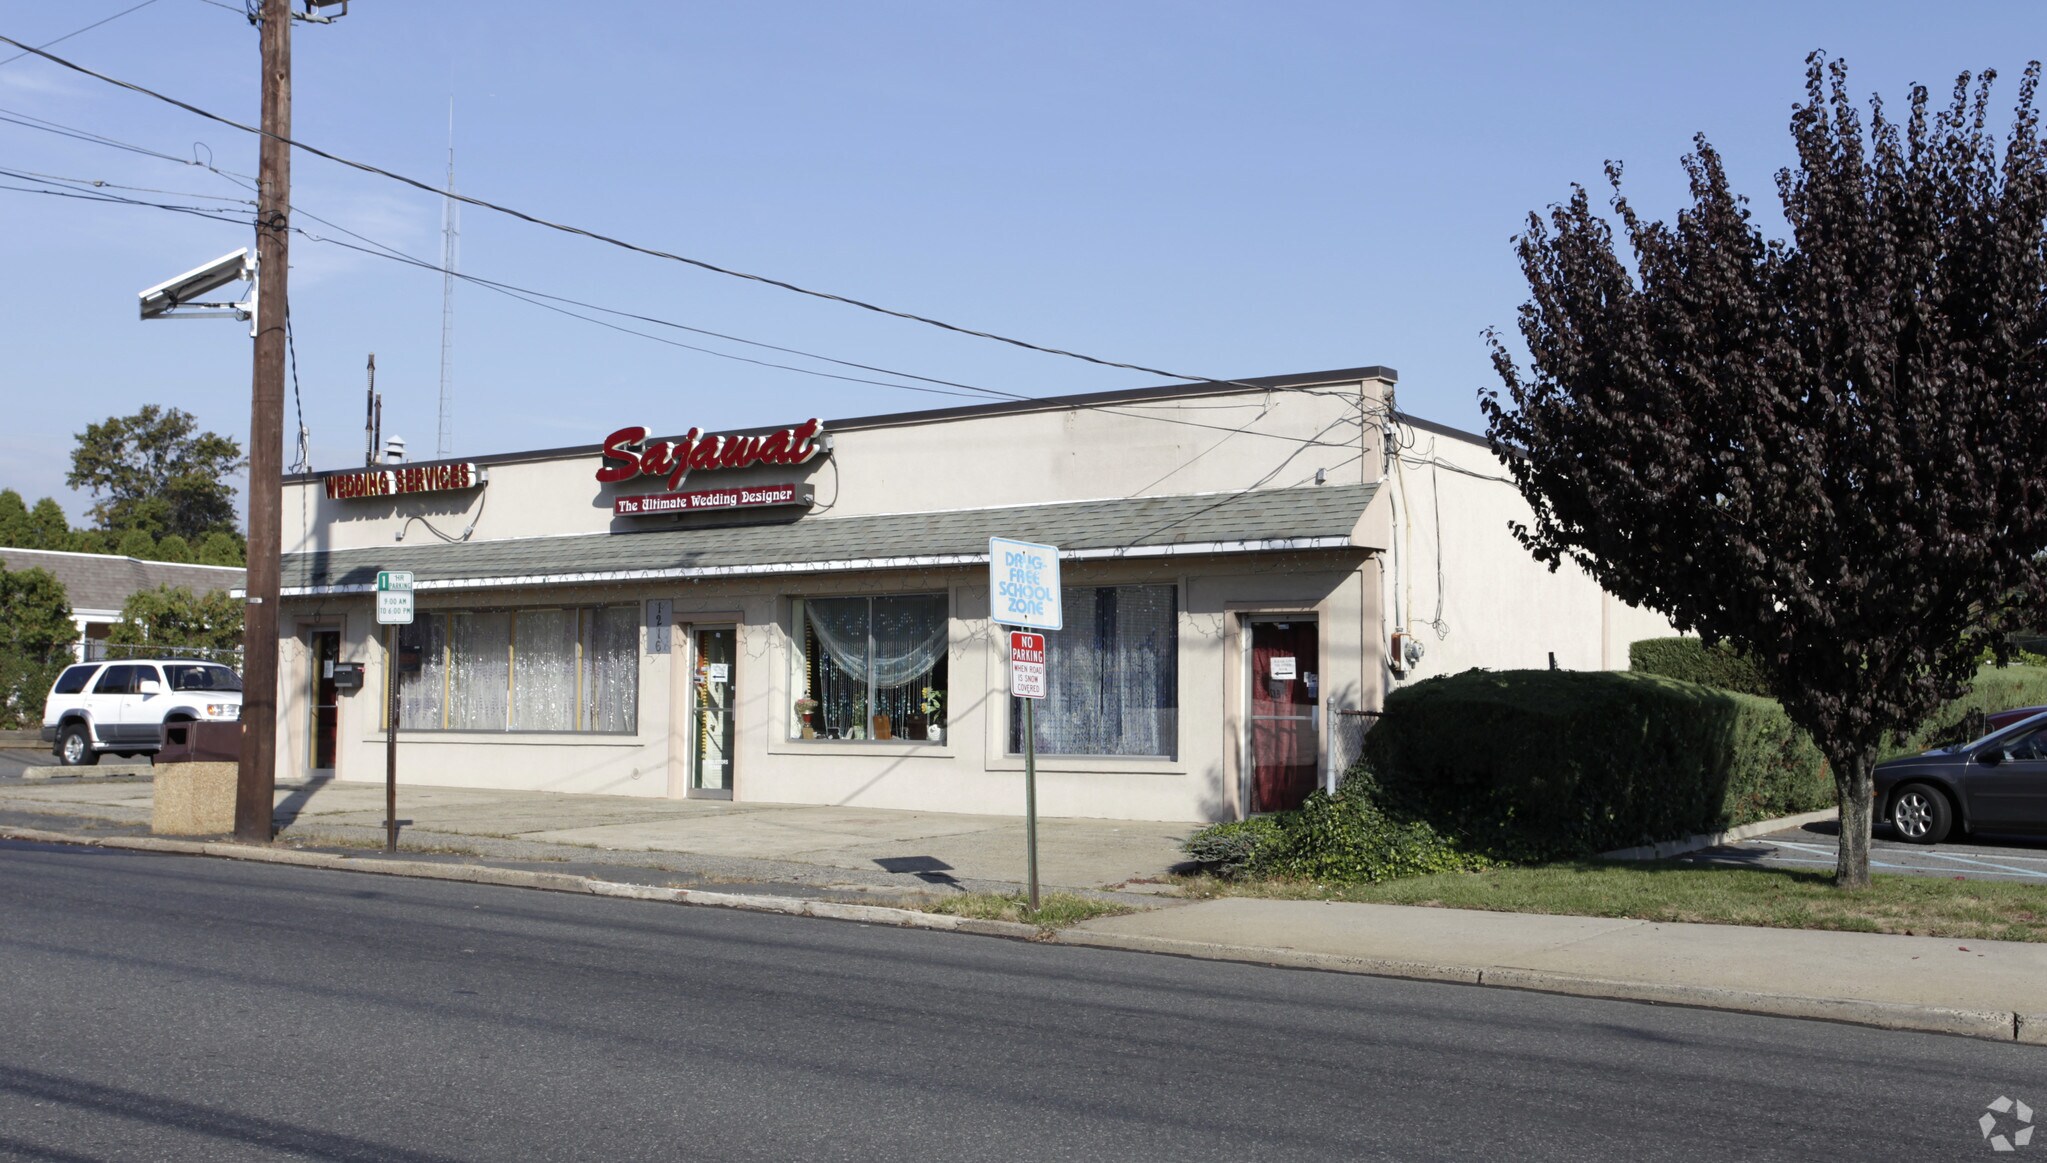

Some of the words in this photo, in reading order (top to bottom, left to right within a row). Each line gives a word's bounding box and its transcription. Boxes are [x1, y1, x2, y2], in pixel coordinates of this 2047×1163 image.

[596, 418, 823, 491] Sajawat
[325, 470, 391, 499] WEDDING
[395, 463, 475, 493] SERVICES
[618, 500, 638, 512] The
[642, 496, 687, 510] Ultimate
[691, 493, 737, 507] Wedding
[741, 490, 792, 504] Designer
[382, 575, 386, 588] 1
[1009, 568, 1040, 585] FREE
[999, 581, 1053, 602] SCHOOL
[1008, 598, 1044, 615] ZONE
[1021, 636, 1033, 648] NO
[1012, 648, 1042, 662] PARKING
[1014, 664, 1028, 672] WHEN
[1029, 666, 1042, 674] ROAD
[1018, 684, 1040, 692] COVERED
